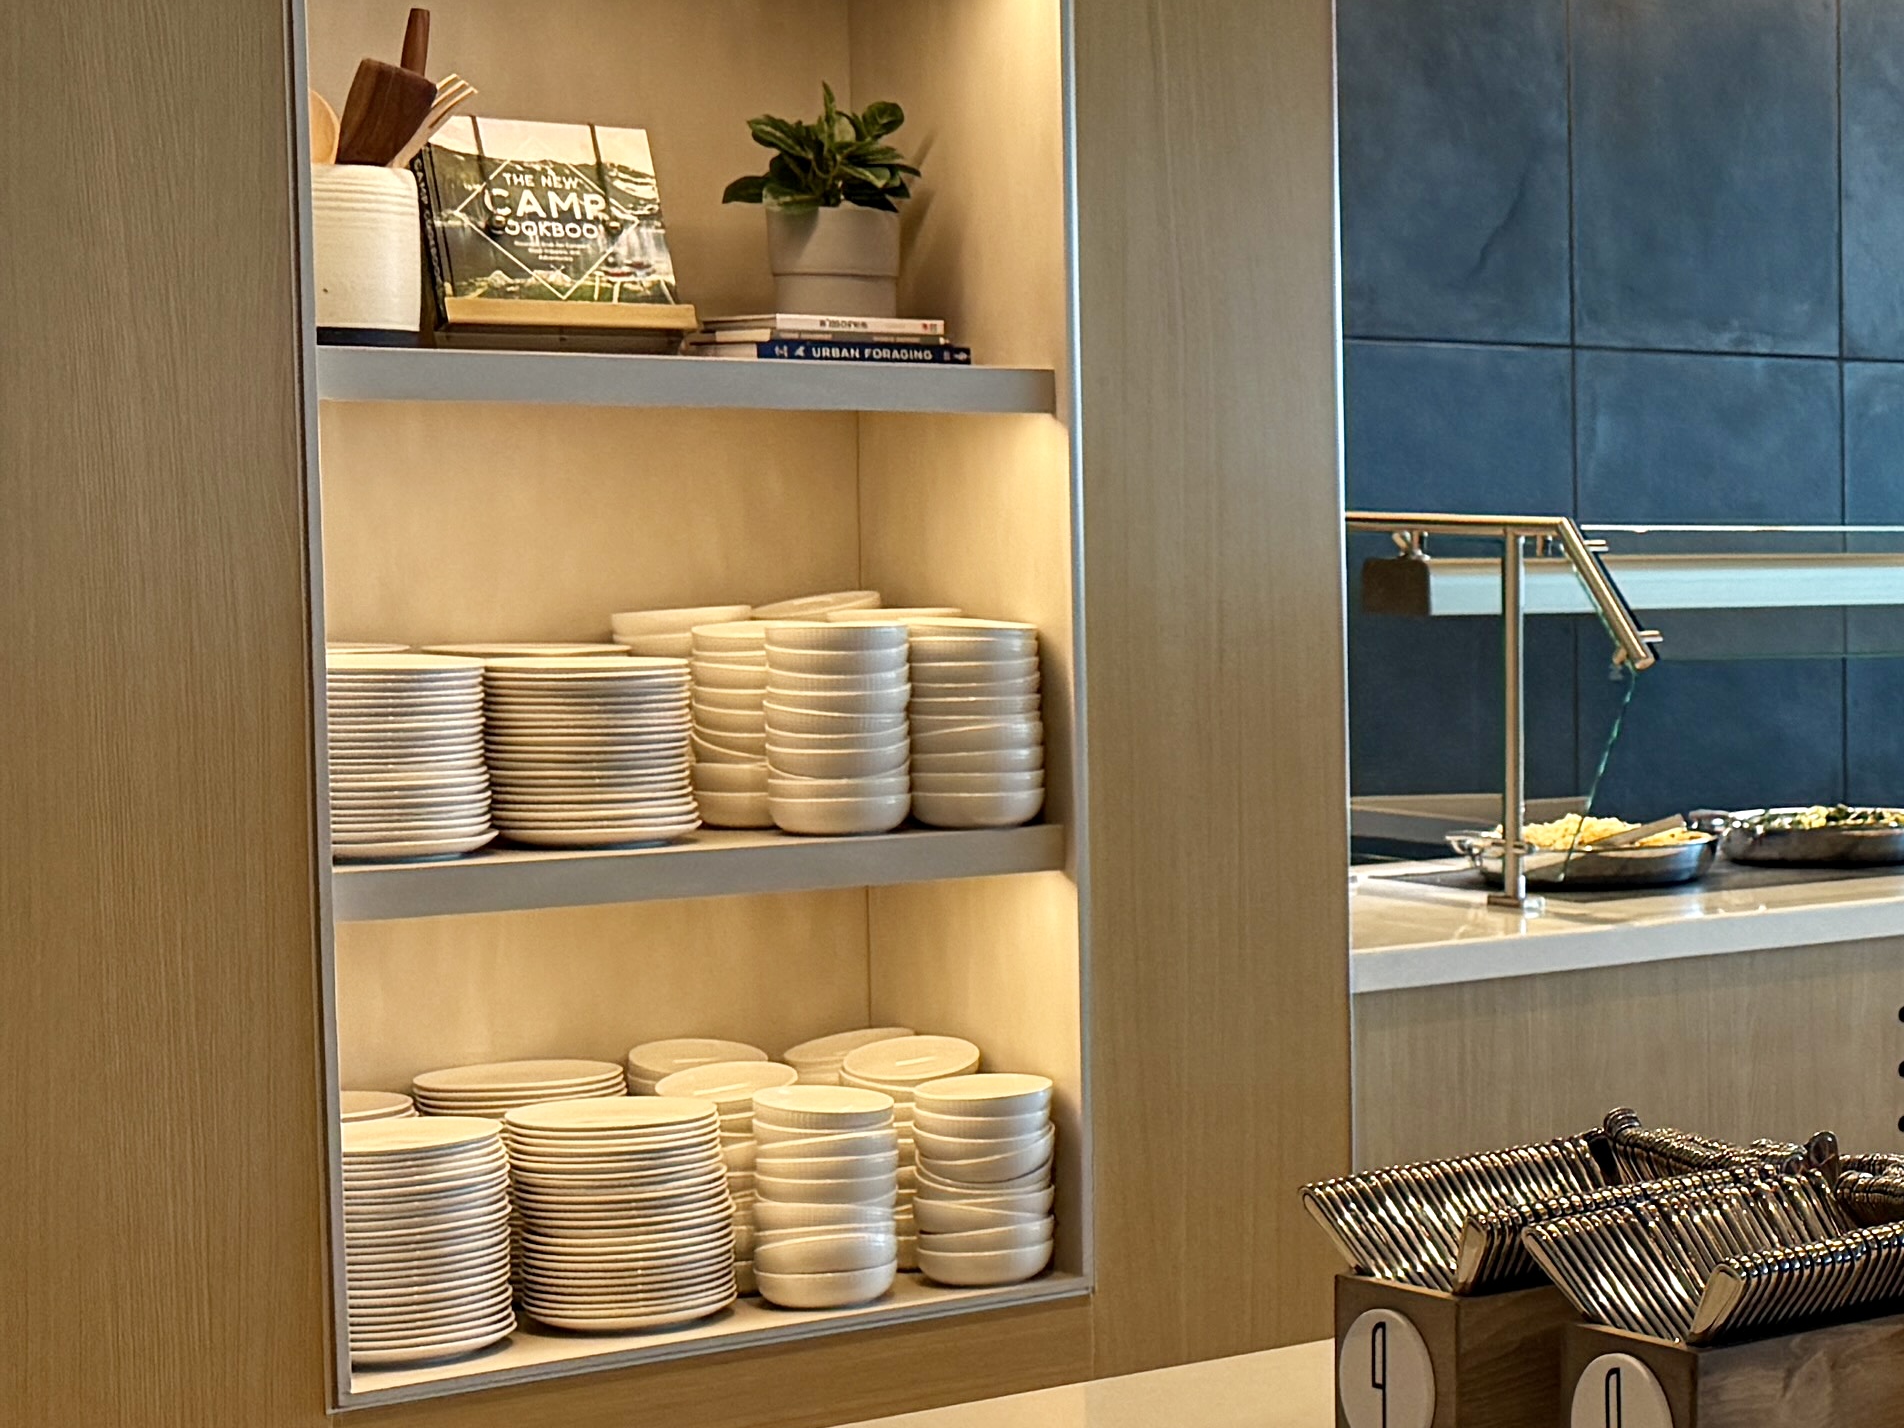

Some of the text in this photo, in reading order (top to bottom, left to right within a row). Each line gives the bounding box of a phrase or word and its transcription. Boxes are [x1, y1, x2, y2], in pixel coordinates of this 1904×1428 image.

[502, 172, 580, 190] THE NEW
[484, 188, 607, 220] CAMP
[491, 217, 607, 240] OOKBOO
[811, 346, 861, 360] URBAN
[864, 347, 934, 361] FORAGING
